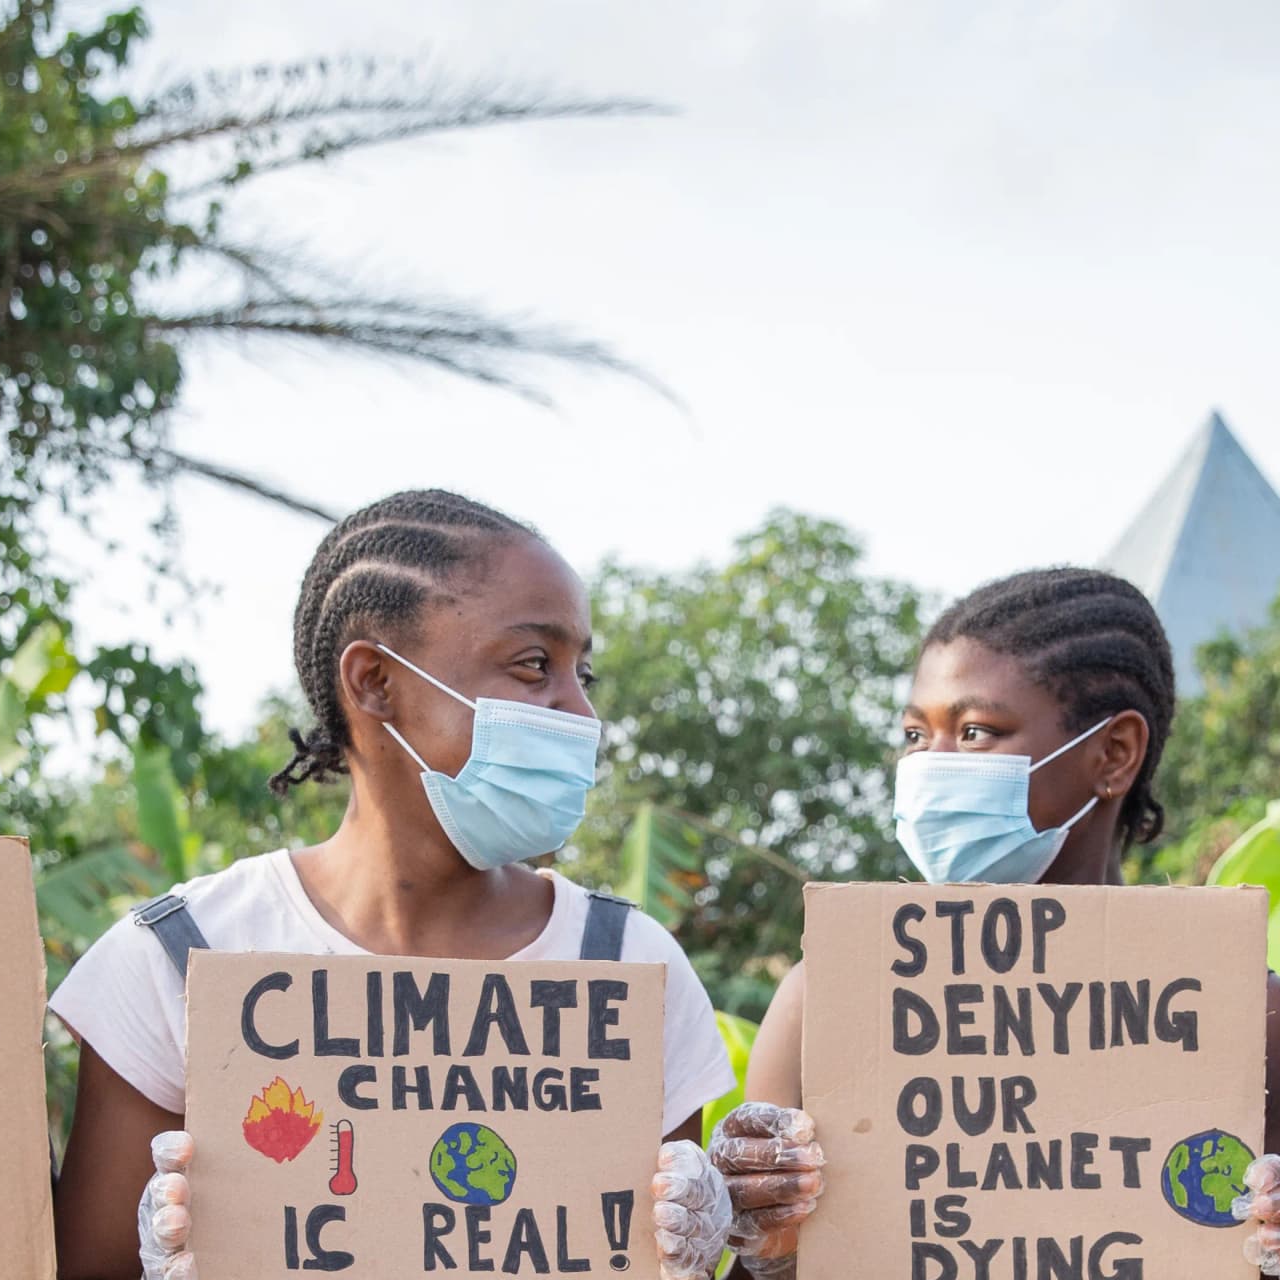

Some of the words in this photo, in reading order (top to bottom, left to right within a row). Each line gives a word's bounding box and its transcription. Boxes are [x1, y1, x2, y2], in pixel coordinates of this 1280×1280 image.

[891, 898, 1065, 977] STOP
[242, 970, 630, 1060] CLIMATE
[893, 978, 1201, 1056] DENYING
[338, 1065, 602, 1112] CHANGE
[897, 1076, 1036, 1136] OUR
[906, 1133, 1150, 1190] PLANET
[423, 1190, 633, 1274] REAL!
[911, 1195, 970, 1237] IS
